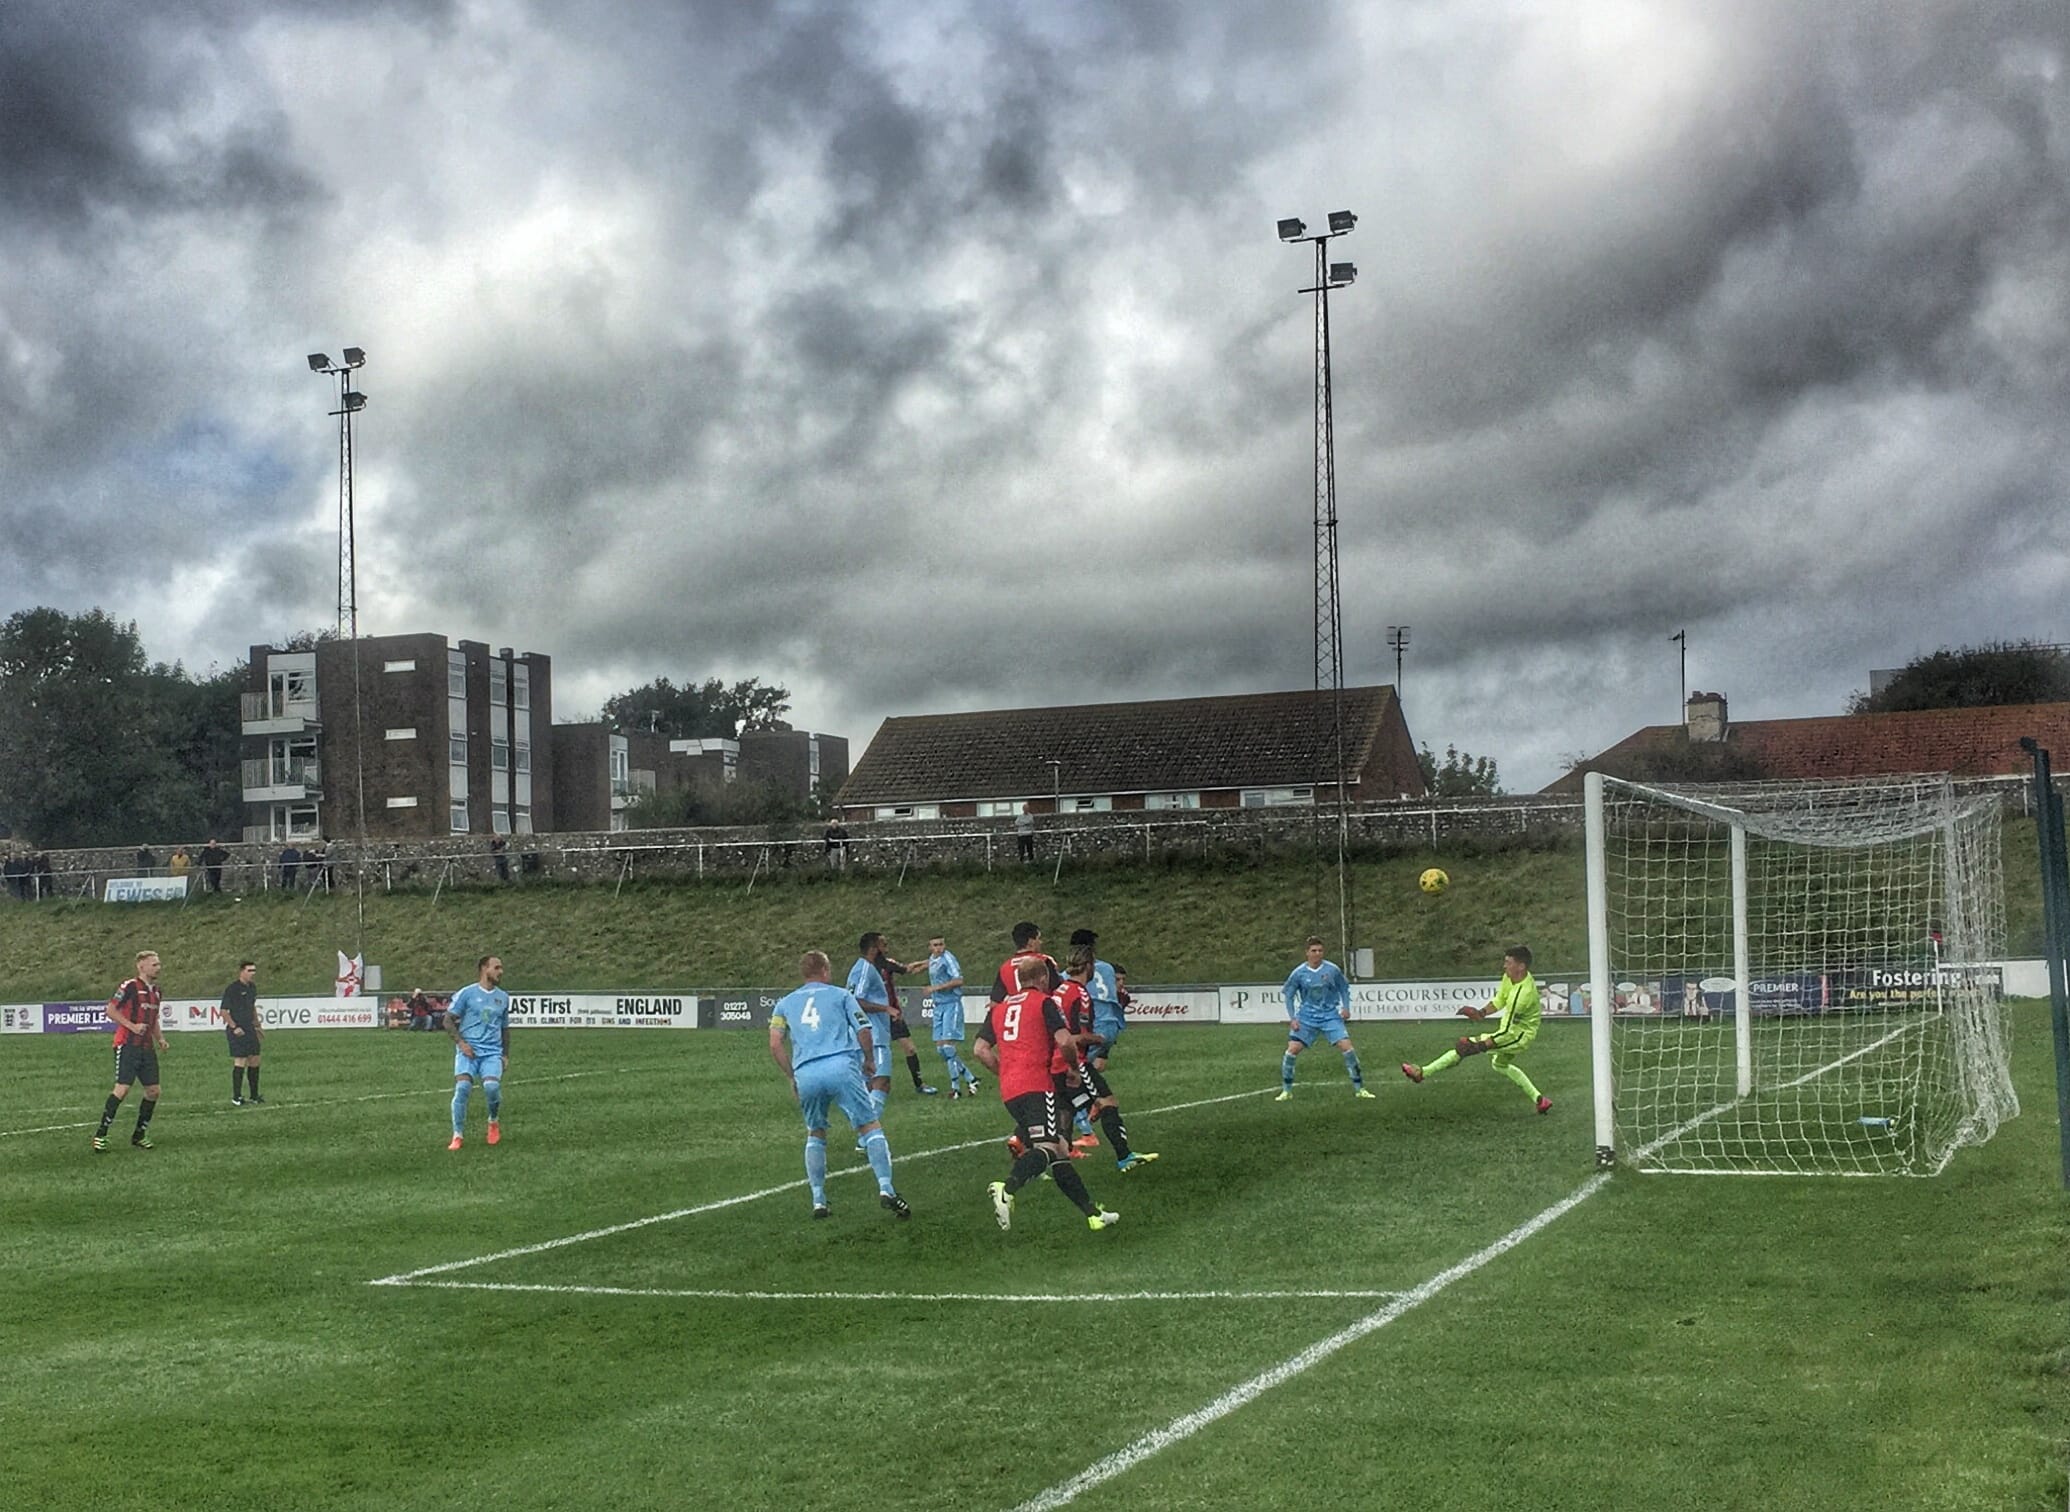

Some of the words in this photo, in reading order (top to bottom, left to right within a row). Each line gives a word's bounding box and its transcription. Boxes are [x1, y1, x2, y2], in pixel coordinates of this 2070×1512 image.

[1872, 968, 1962, 988] Fostering
[1753, 982, 1799, 993] PREMIER
[1850, 989, 1866, 999] Are
[1890, 988, 1907, 998] the
[508, 998, 536, 1014] AST
[540, 998, 571, 1014] First
[616, 998, 682, 1015] ENGLAND
[801, 996, 820, 1031] 4
[1124, 999, 1189, 1018] Siempre
[1377, 1004, 1410, 1013] HEART
[1415, 1003, 1427, 1013] OF
[1433, 1002, 1460, 1013] SUSS
[48, 1012, 91, 1025] PREMIER
[92, 1012, 114, 1024] LEA
[1003, 1004, 1022, 1041] 9
